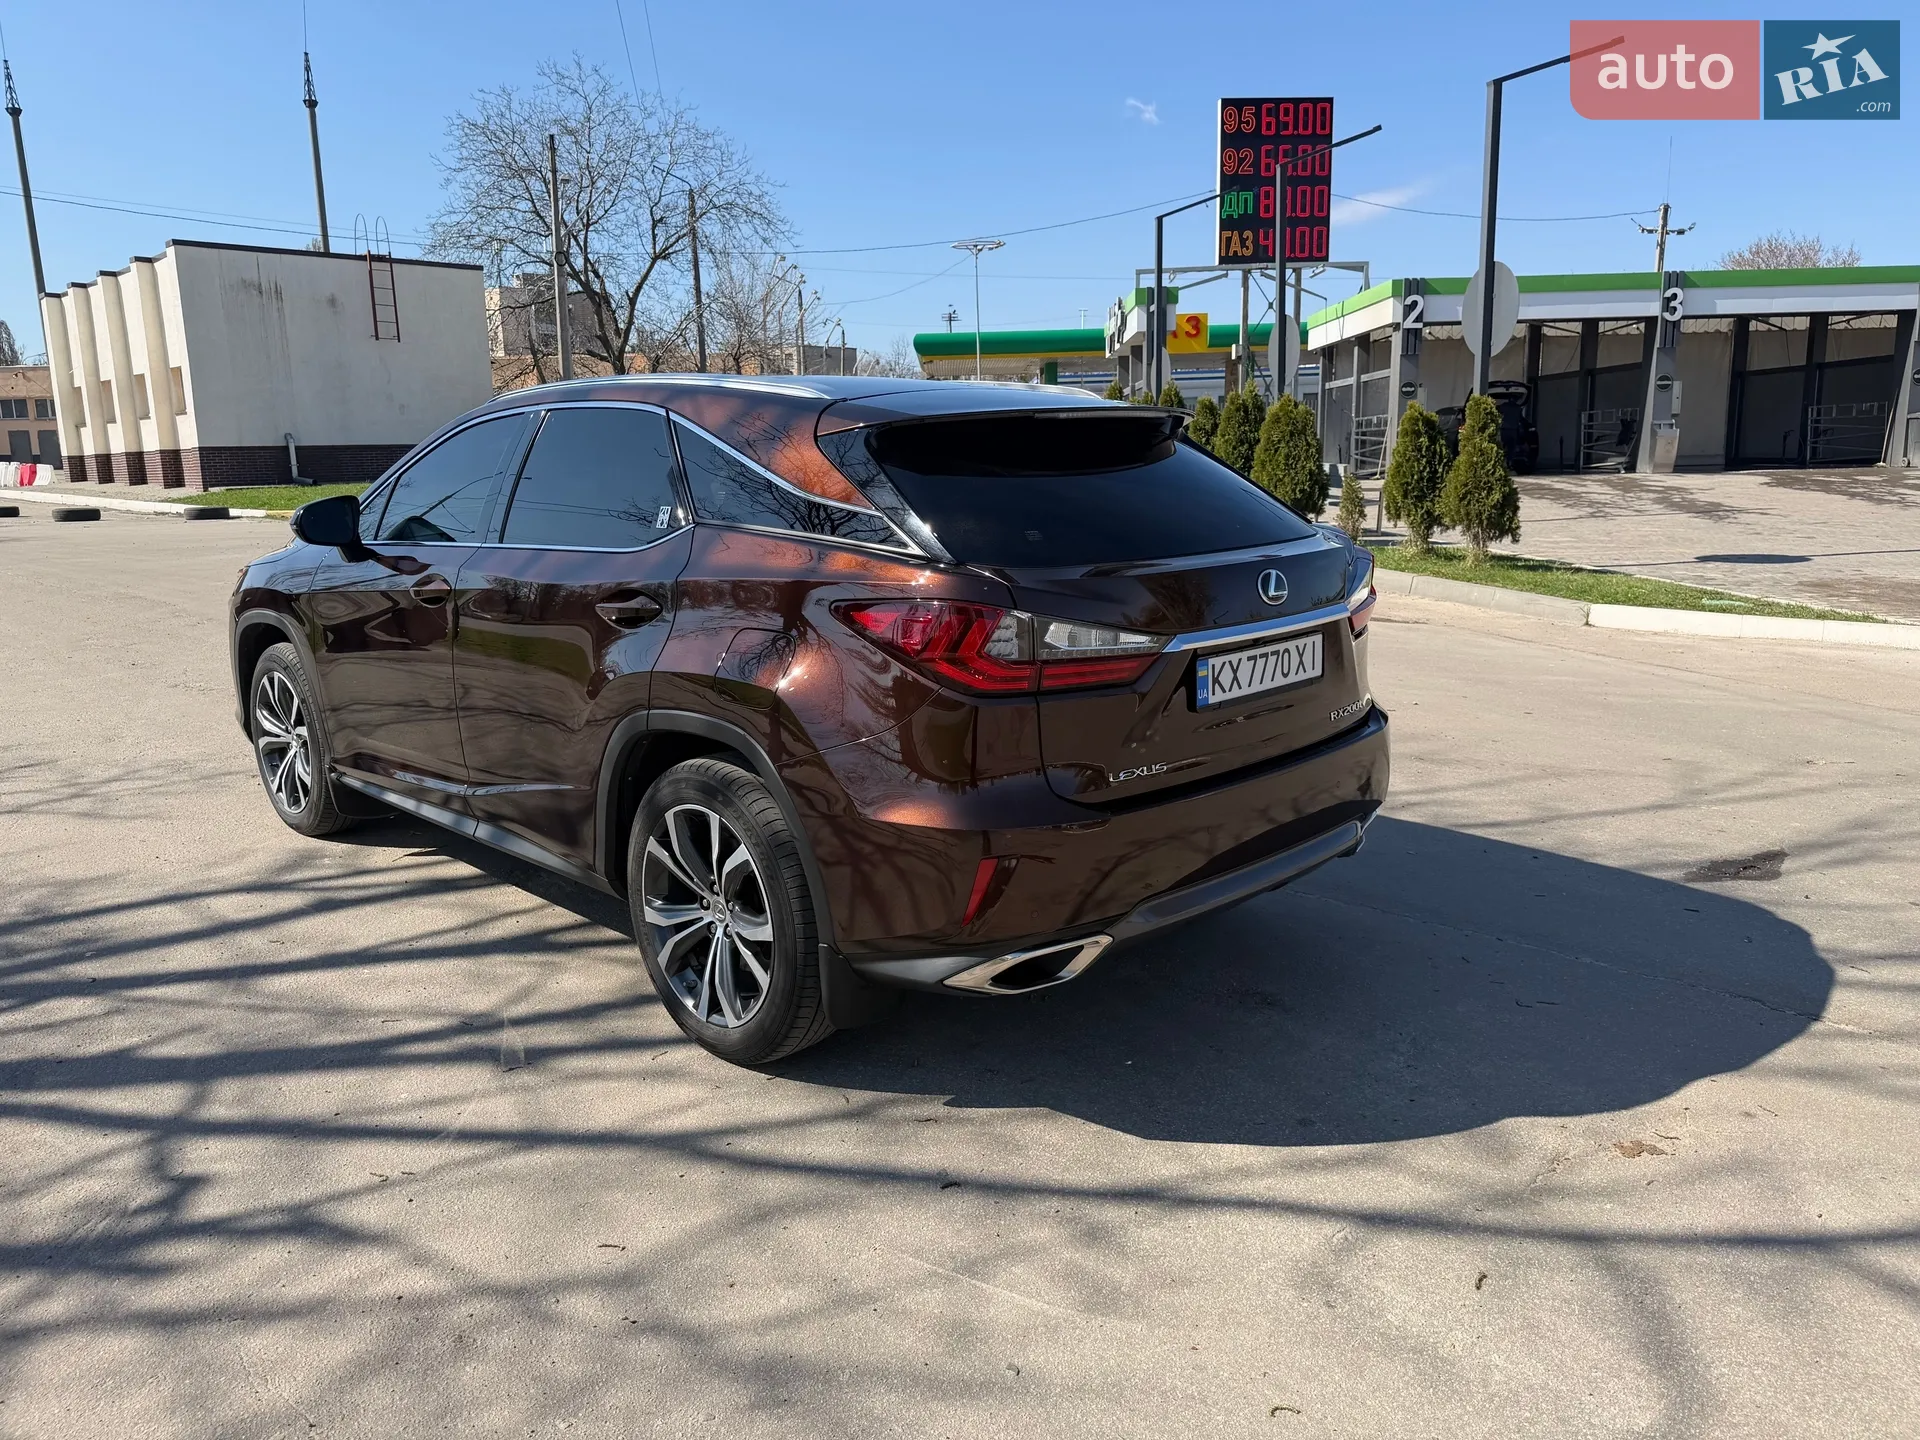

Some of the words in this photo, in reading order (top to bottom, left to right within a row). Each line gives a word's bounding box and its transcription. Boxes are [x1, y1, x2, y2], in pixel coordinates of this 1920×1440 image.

[1223, 106, 1256, 133] 95
[1261, 103, 1331, 136] 69.00
[1222, 147, 1254, 175] 92
[1221, 191, 1254, 219] ДП
[1220, 230, 1254, 257] ГАЗ
[1403, 295, 1424, 329] 2
[1662, 287, 1684, 322] 3
[1198, 688, 1208, 699] UA
[1108, 761, 1167, 782] LEXUS
